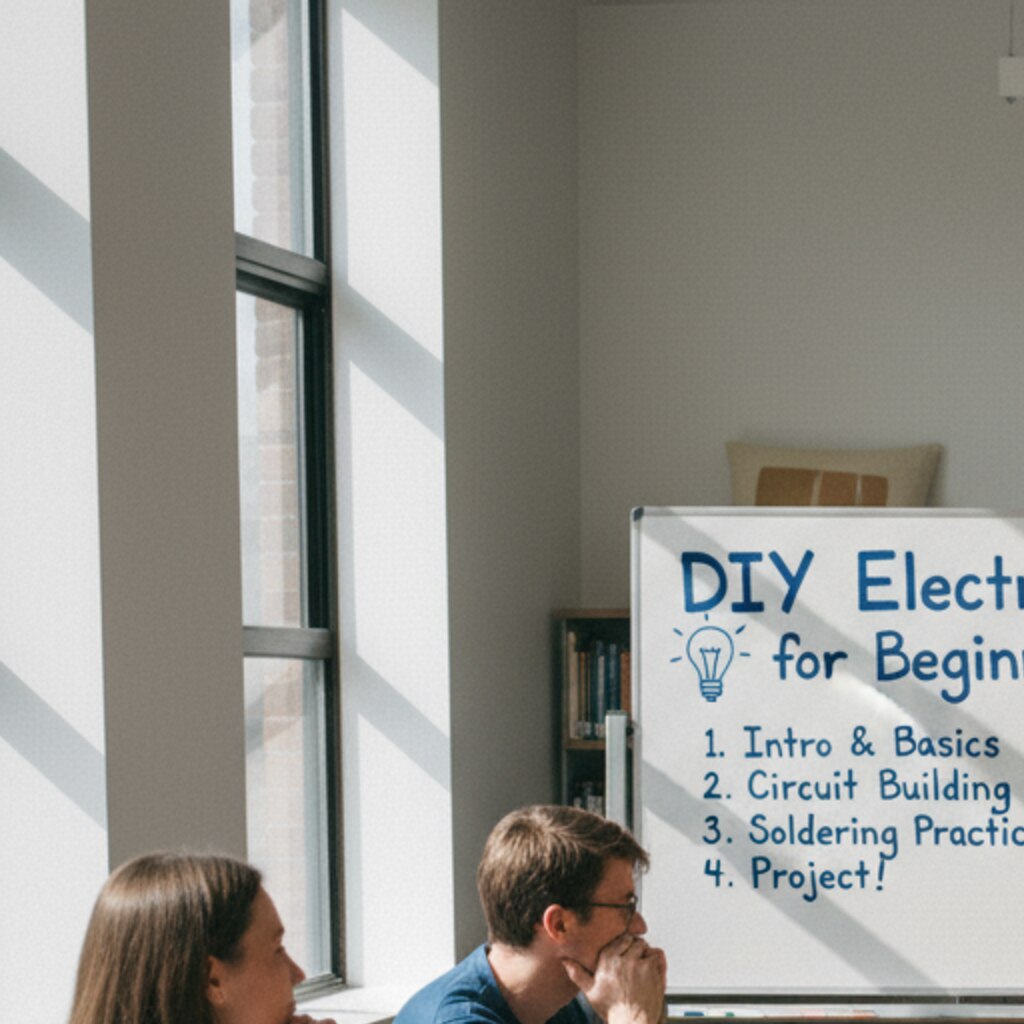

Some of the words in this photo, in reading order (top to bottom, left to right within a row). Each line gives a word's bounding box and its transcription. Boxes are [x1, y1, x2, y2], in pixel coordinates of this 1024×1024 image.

[680, 549, 815, 613] DIY
[772, 631, 848, 681] for
[704, 728, 726, 758] 1.
[743, 725, 832, 758] Intro
[851, 726, 876, 757] &
[894, 724, 1001, 758] Basics
[703, 771, 731, 800] 2.
[747, 768, 858, 801] Circuit
[879, 767, 1012, 815] Building
[702, 816, 733, 845] 3.
[748, 813, 899, 860] Soldering
[703, 860, 733, 888] 4.
[751, 857, 886, 902] Project!
